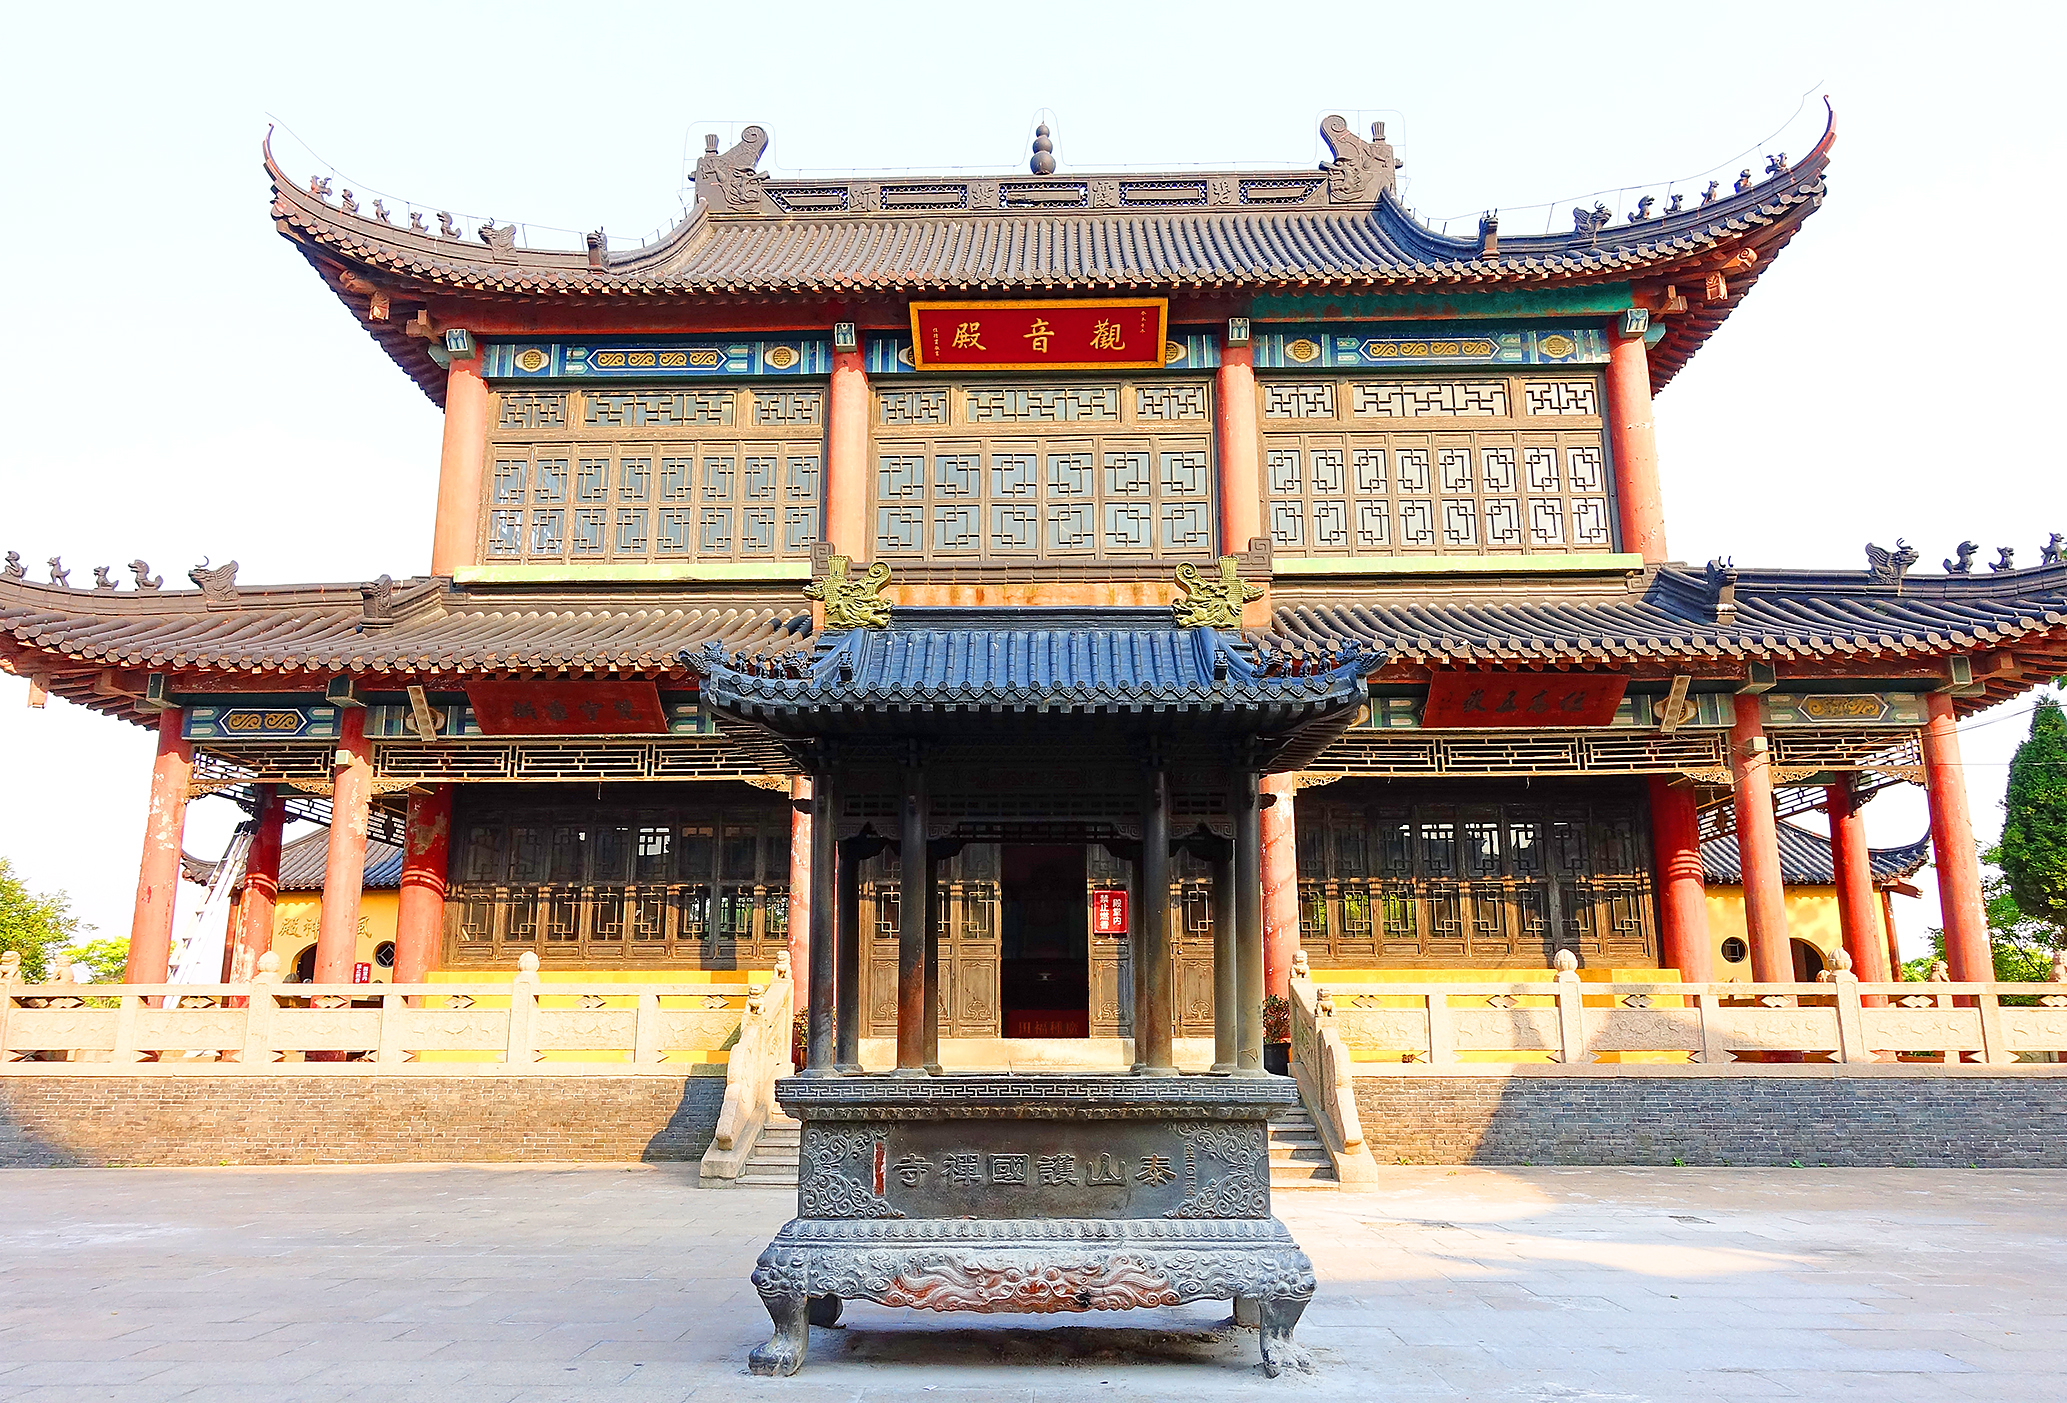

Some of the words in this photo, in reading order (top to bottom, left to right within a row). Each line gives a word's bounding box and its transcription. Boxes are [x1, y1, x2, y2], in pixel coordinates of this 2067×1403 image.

[951, 317, 1126, 353] 觀音殿
[892, 1152, 1178, 1187] 泰山護國禪寺
